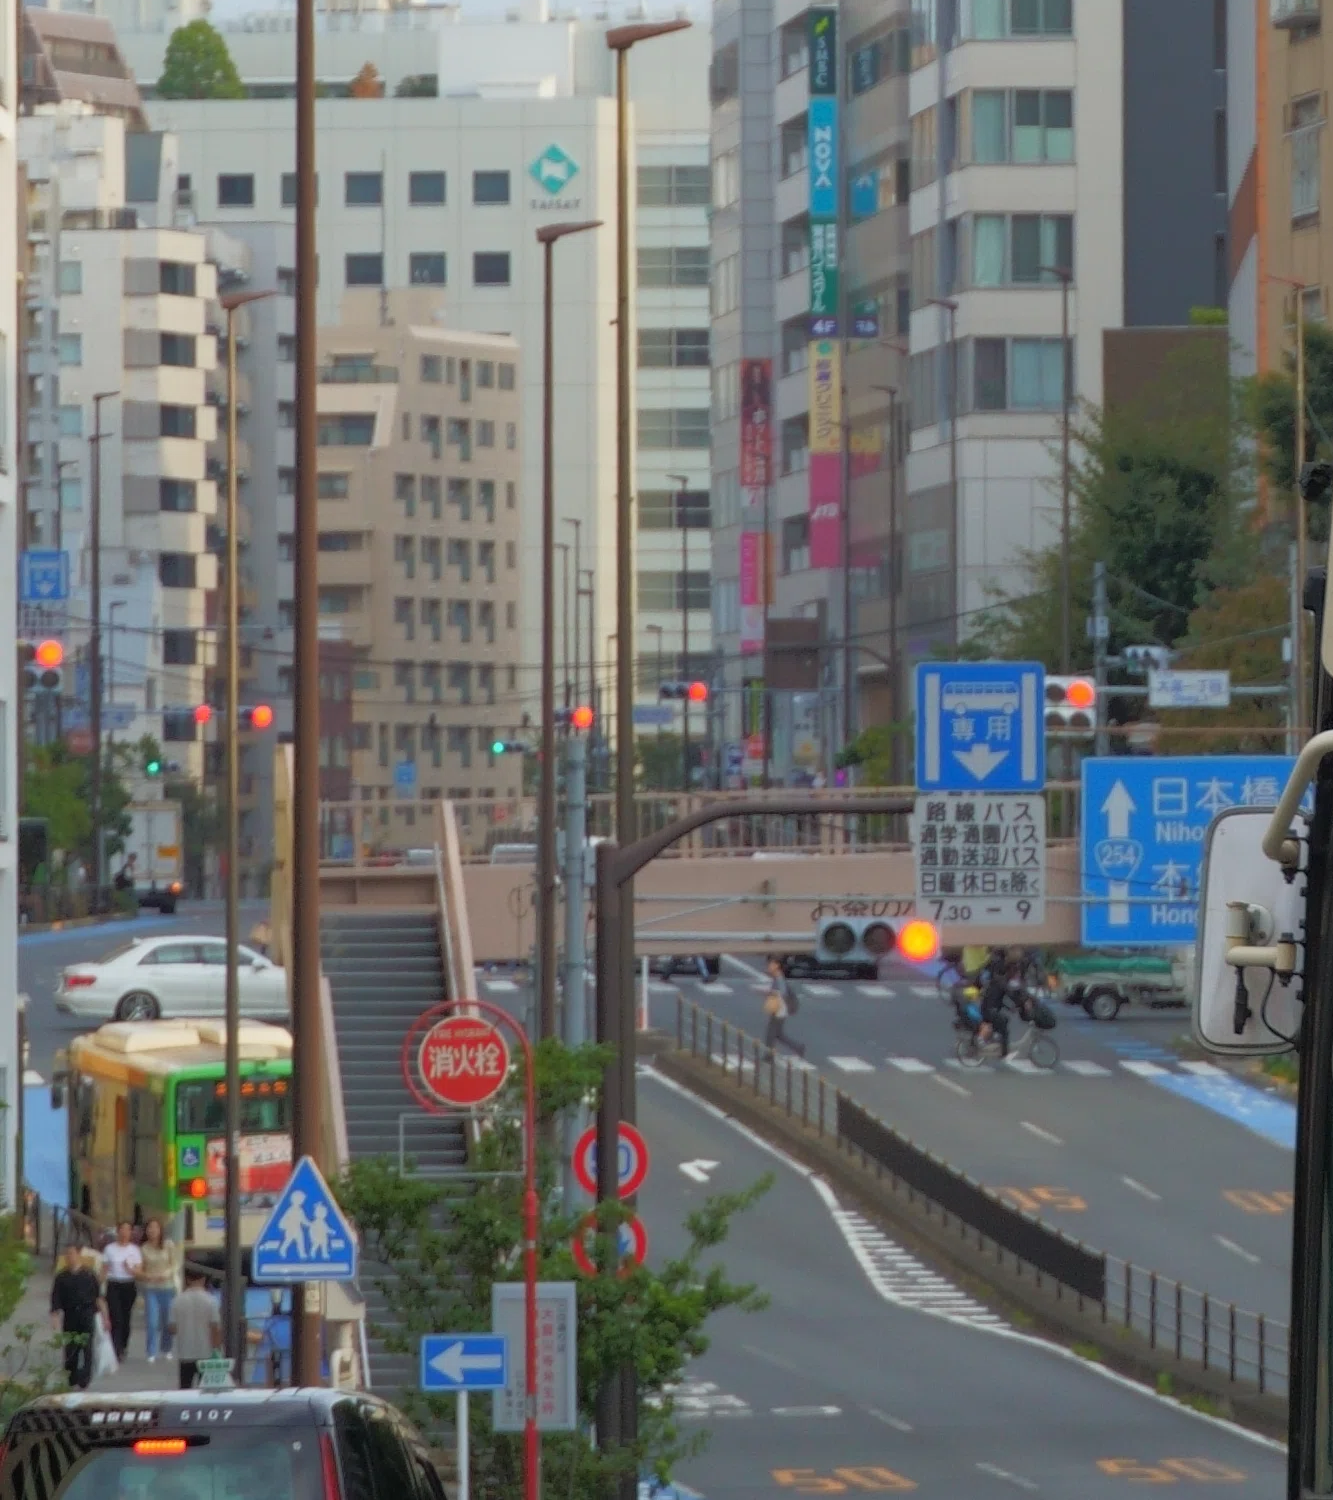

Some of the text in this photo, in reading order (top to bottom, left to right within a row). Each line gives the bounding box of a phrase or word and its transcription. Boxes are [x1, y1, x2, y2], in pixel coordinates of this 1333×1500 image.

[814, 126, 832, 188] NOVA
[812, 319, 836, 335] 4F
[951, 714, 1013, 741] 専用
[926, 801, 1034, 822] 路線バス
[1155, 820, 1208, 844] Niho
[1100, 845, 1137, 867] 254
[428, 1043, 501, 1079] 消火栓
